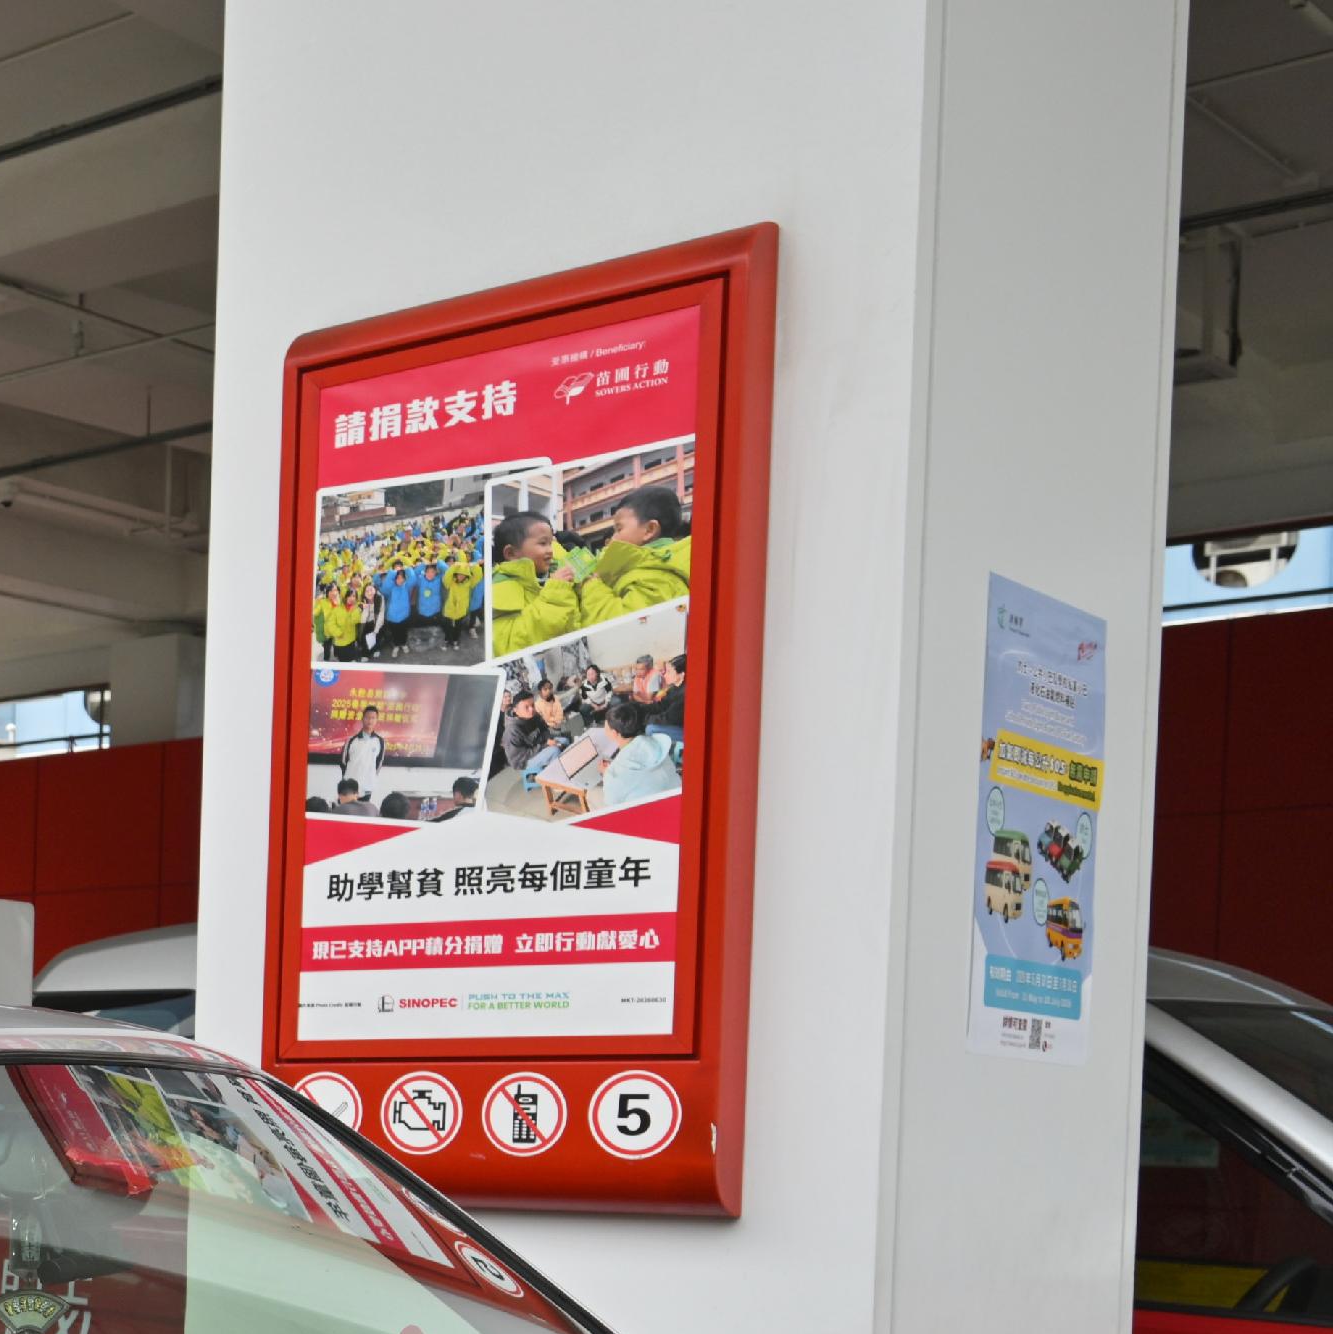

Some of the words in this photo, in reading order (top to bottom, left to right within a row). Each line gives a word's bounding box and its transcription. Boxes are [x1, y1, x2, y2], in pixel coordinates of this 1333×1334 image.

[595, 384, 631, 398] SOWERS
[633, 377, 669, 390] ACTION
[334, 380, 517, 449] 請捐款支持
[454, 856, 651, 897] 照亮每個童年
[399, 997, 458, 1009] SINOPEC
[468, 1001, 486, 1010] FOR
[497, 1001, 531, 1010] BETTER
[533, 1000, 570, 1009] WORLD
[616, 1093, 652, 1137] 5
